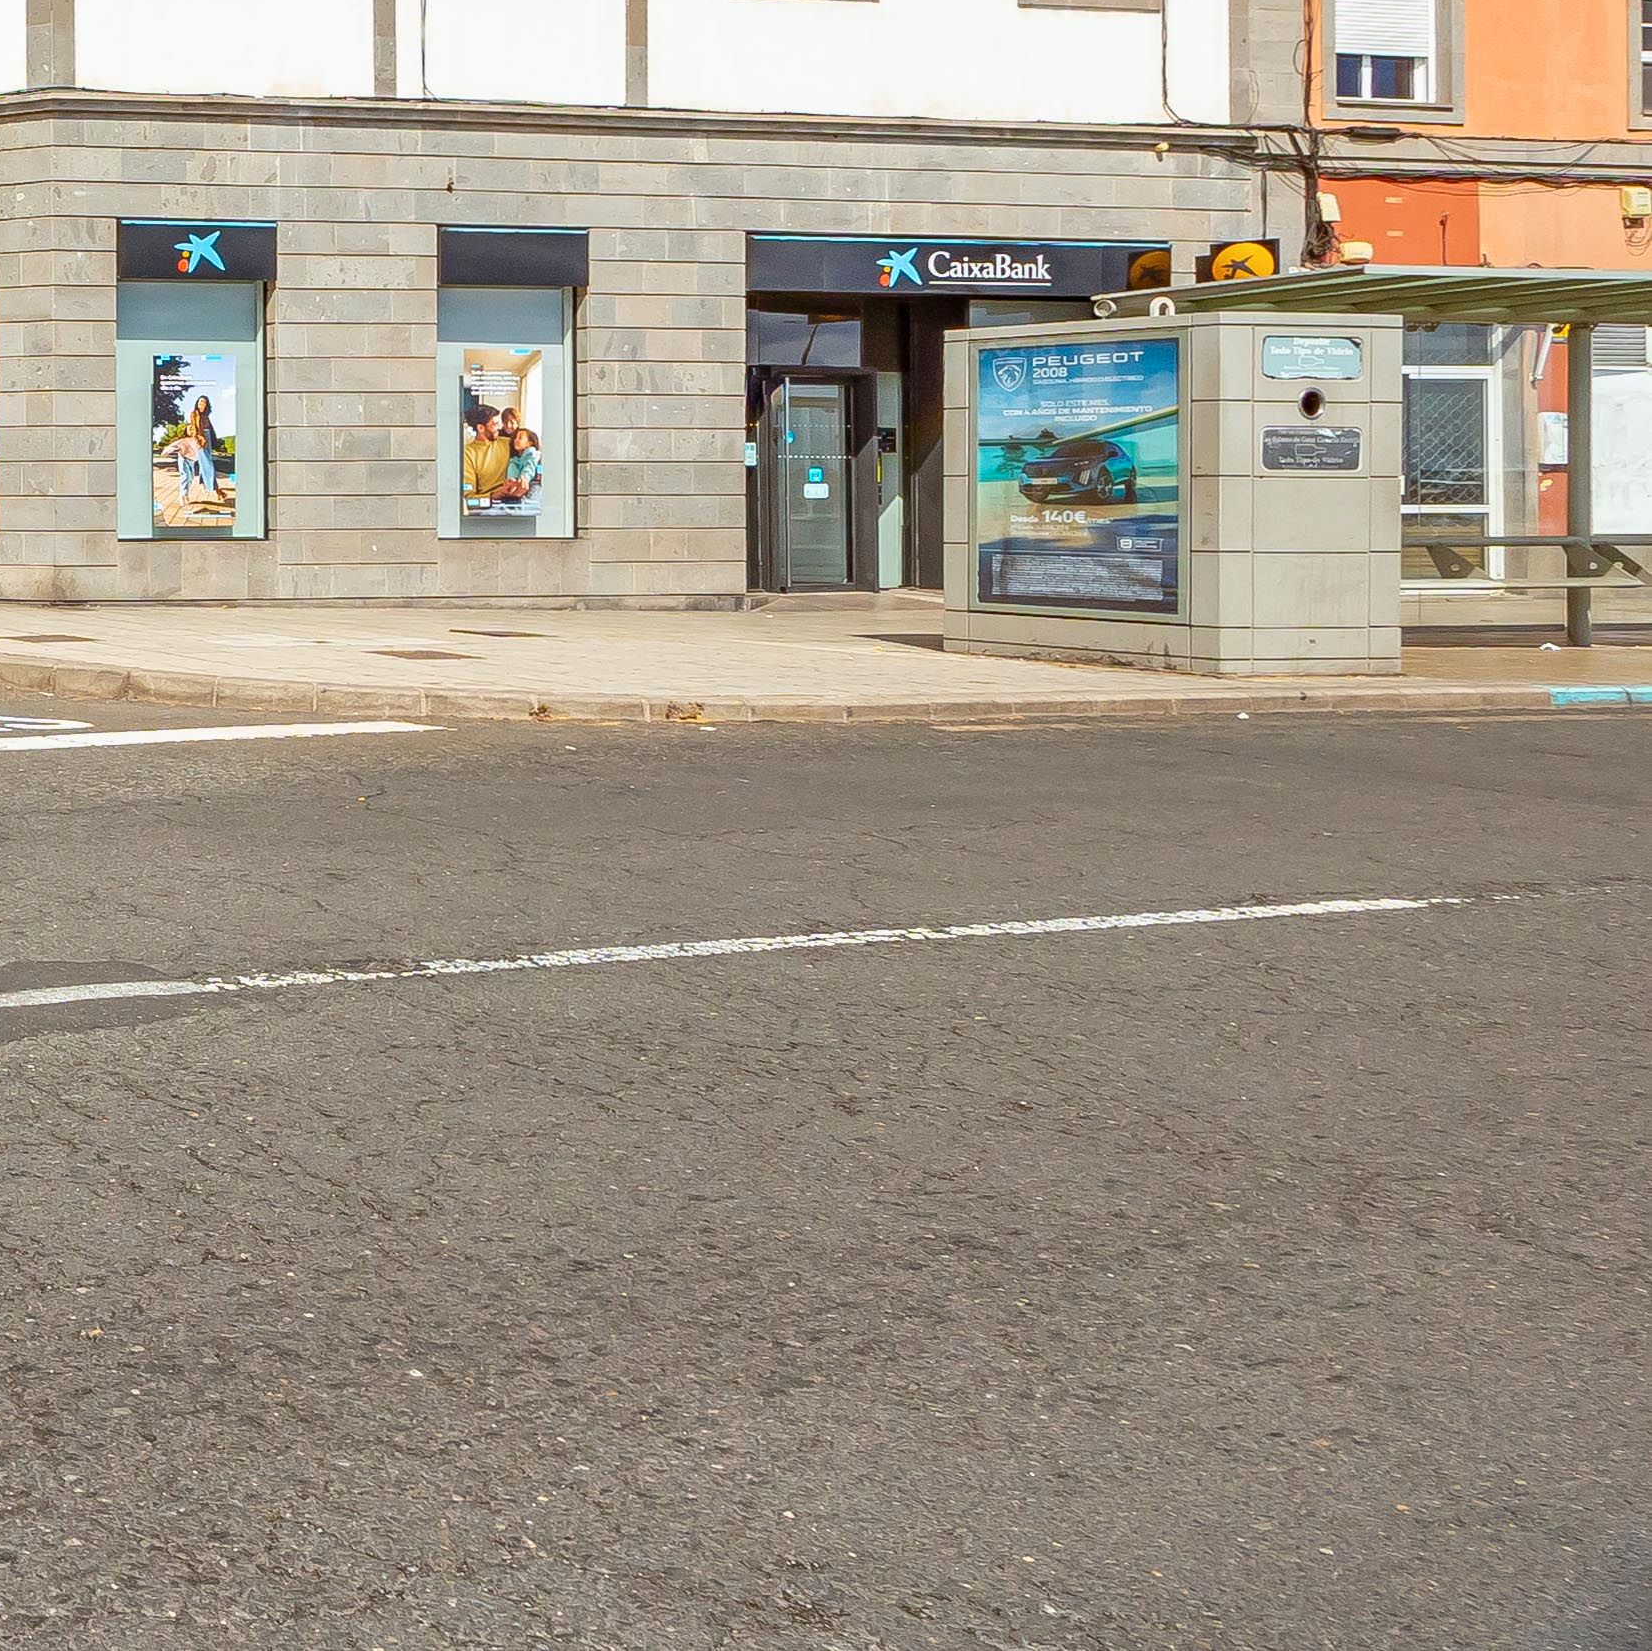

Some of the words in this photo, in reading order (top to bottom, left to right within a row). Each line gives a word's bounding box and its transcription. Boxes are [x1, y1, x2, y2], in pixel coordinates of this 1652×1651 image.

[927, 250, 1052, 279] CaixaBank
[1032, 351, 1145, 367] PEUGEOT
[1032, 367, 1068, 379] 2008
[1057, 407, 1070, 415] DE
